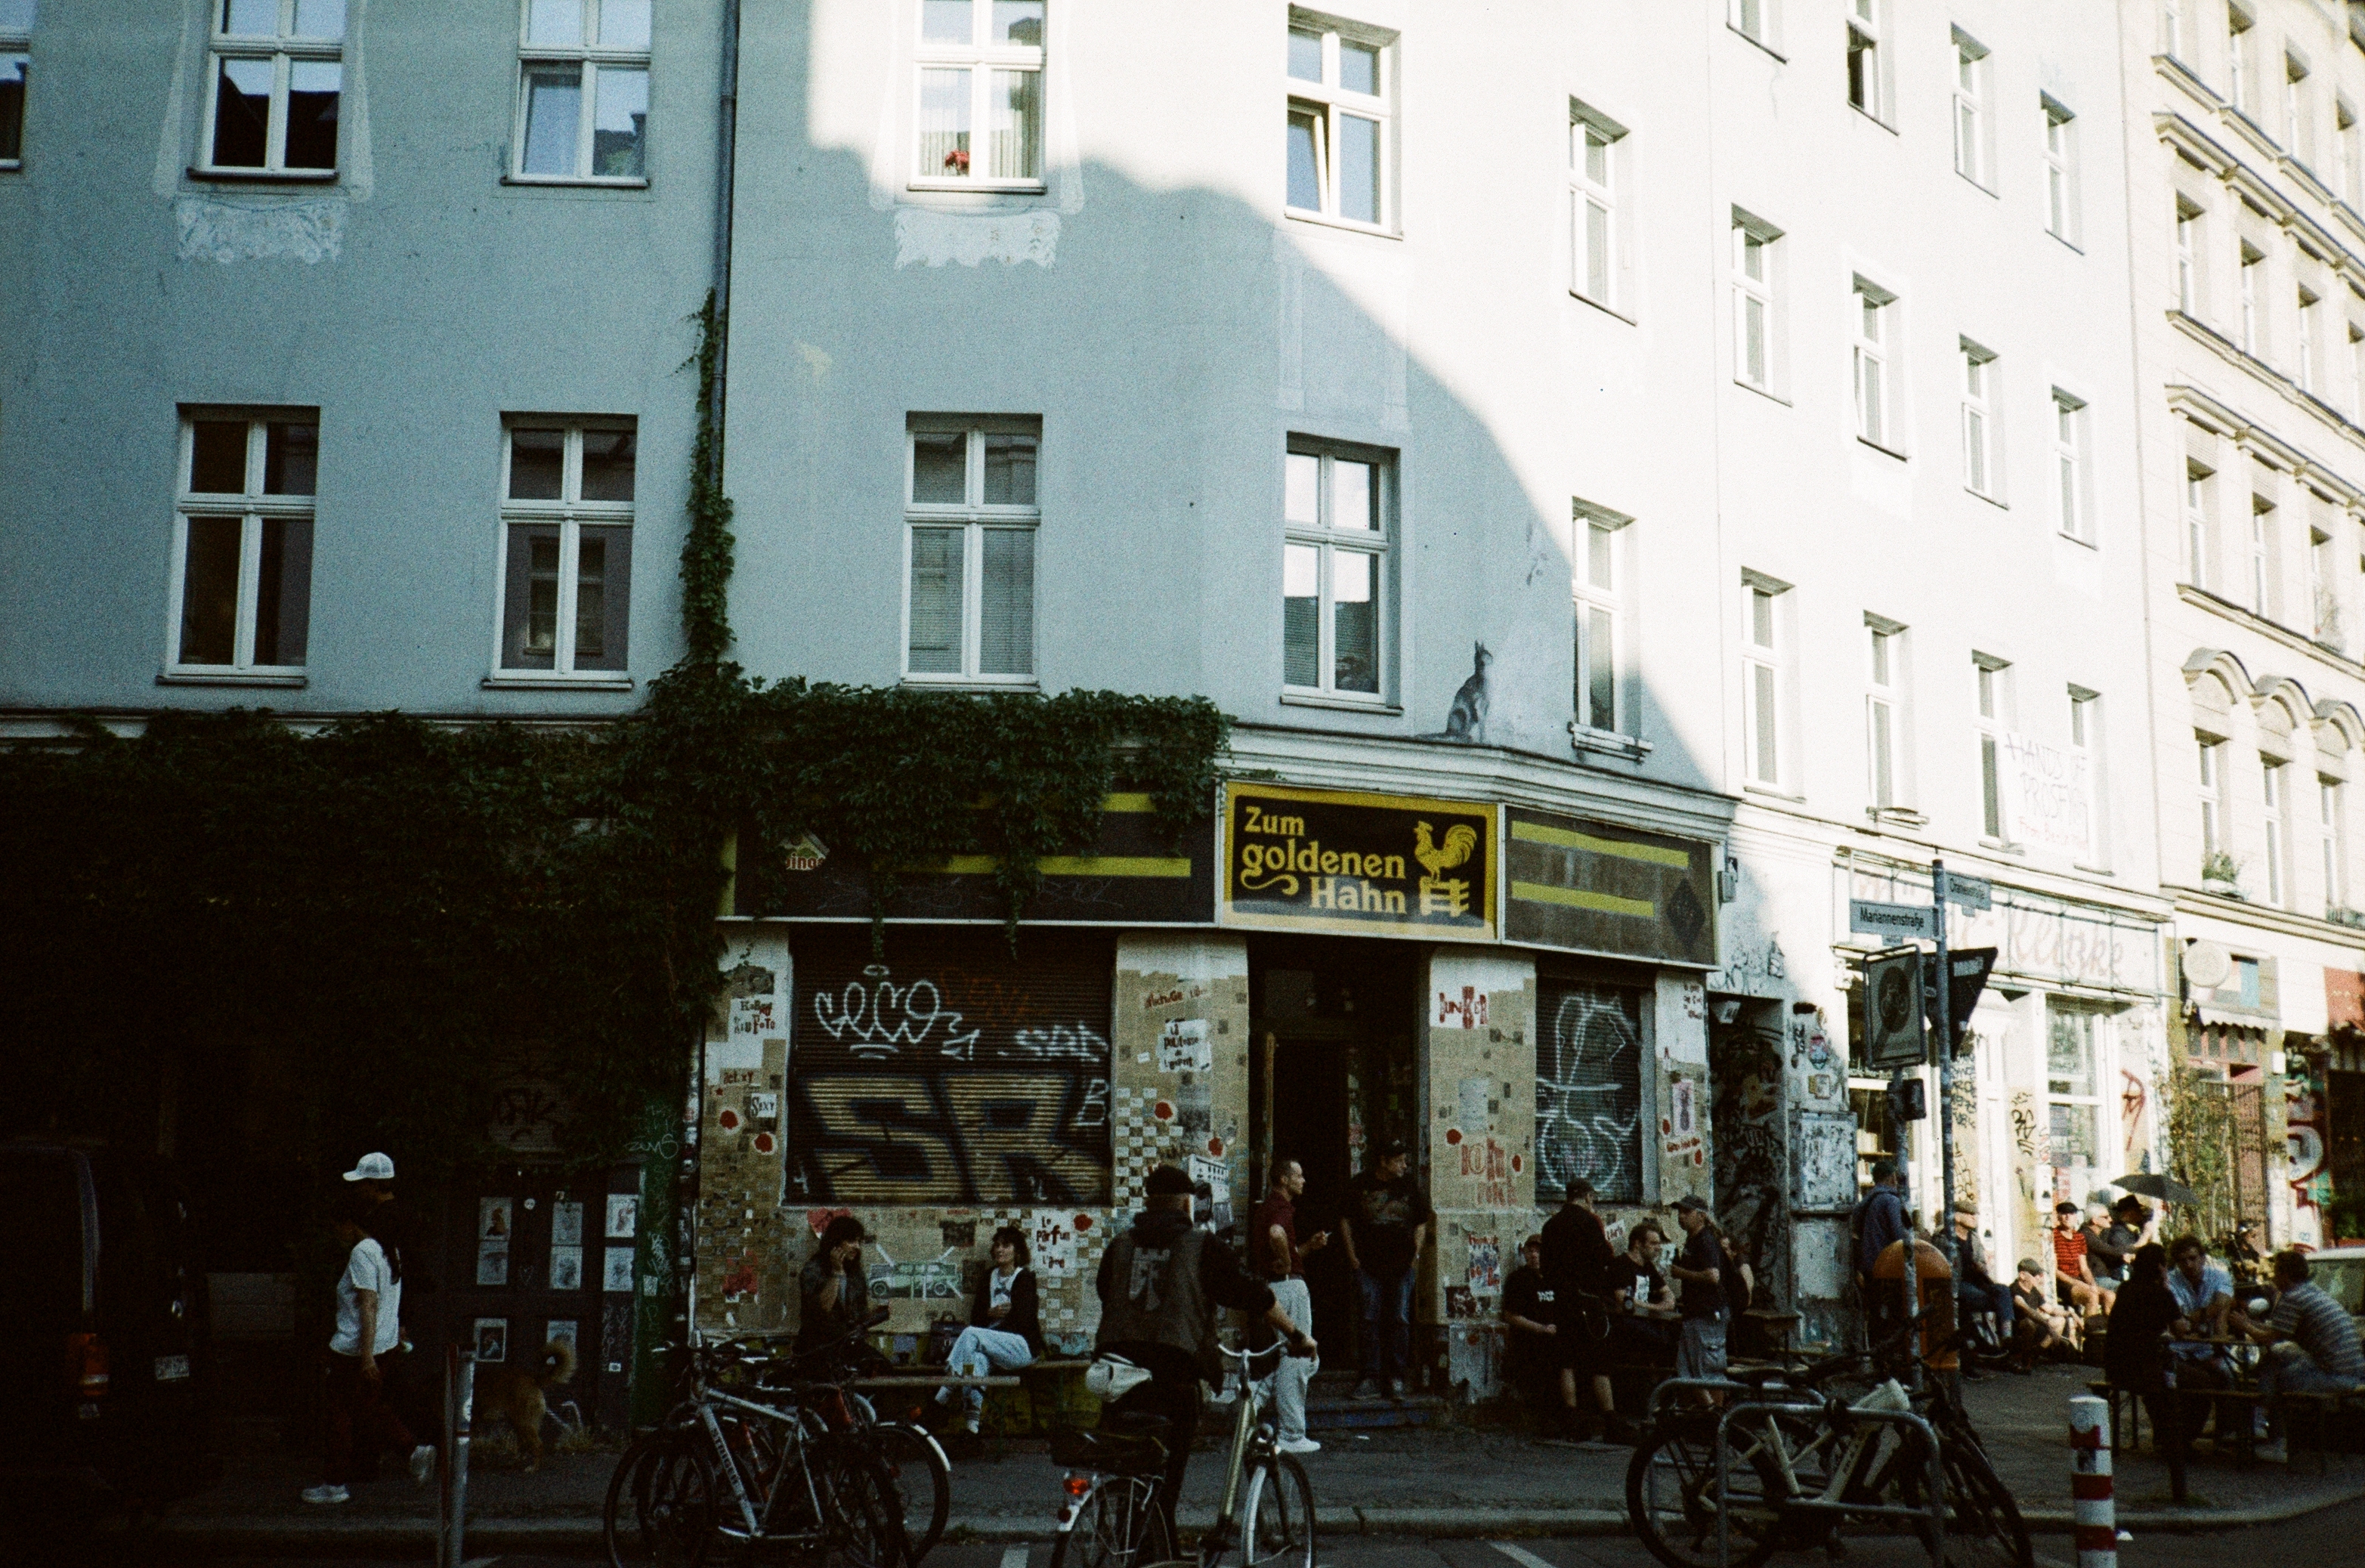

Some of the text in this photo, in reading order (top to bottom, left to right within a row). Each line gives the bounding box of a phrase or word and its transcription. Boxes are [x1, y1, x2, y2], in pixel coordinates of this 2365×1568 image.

[1244, 806, 1305, 837] Zum
[1240, 838, 1407, 895] goldenen
[1309, 874, 1408, 914] Hahn
[1860, 906, 1925, 932] Mariannenstraße
